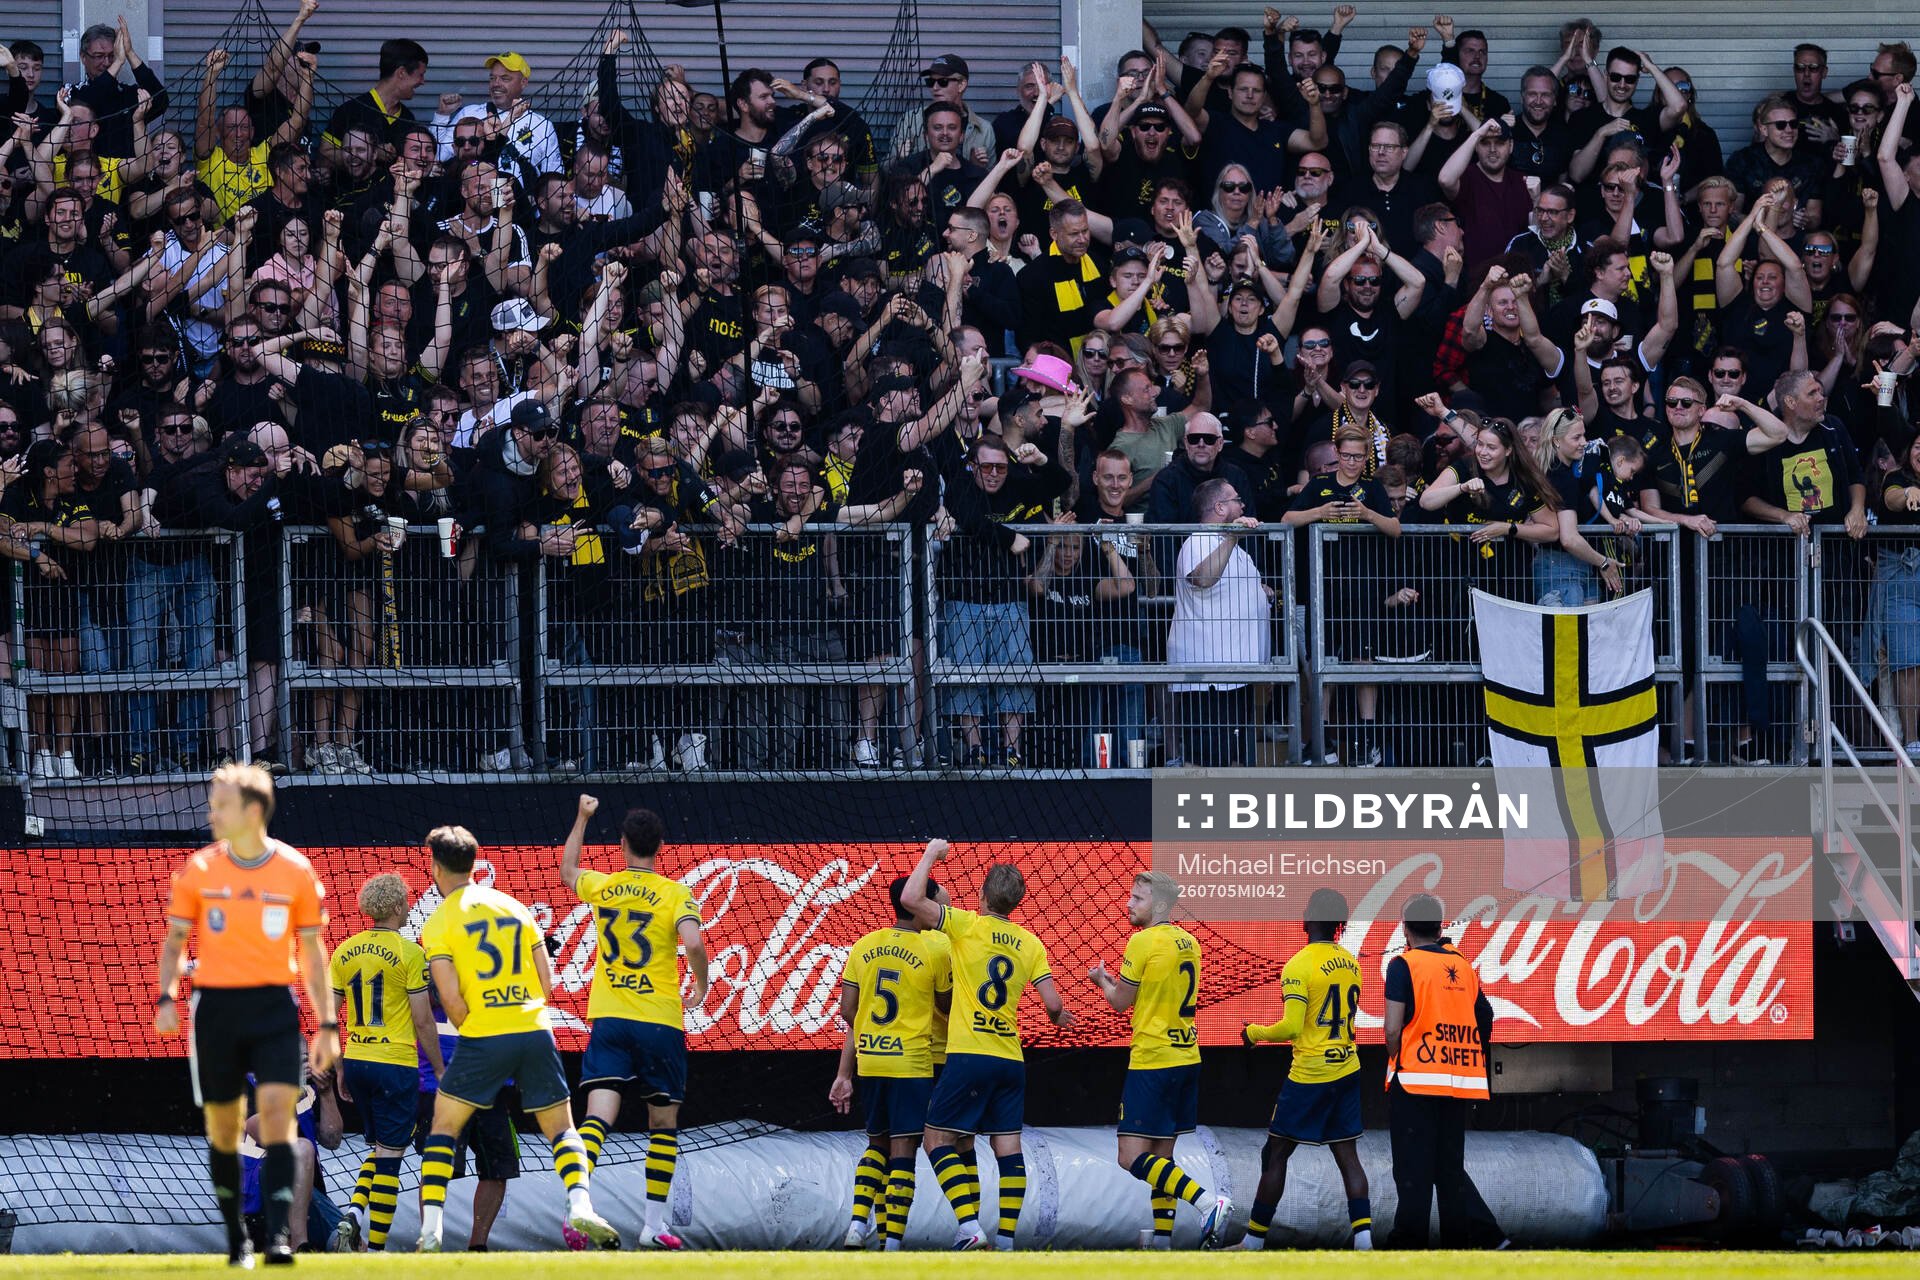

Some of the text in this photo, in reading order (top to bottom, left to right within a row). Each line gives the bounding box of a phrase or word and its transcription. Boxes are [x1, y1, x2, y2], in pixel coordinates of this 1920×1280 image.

[601, 884, 661, 907] CSONGVAI
[464, 916, 523, 980] 37
[598, 906, 654, 970] 33
[992, 932, 1022, 951] HOVE
[340, 943, 401, 968] ANDERSSON
[862, 945, 924, 970] BERGQUIST
[347, 968, 386, 1027] 11
[482, 985, 533, 1004] SVEA
[871, 967, 901, 1026] 5
[977, 954, 1014, 1011] 8
[1178, 961, 1197, 1018] 2
[1316, 984, 1360, 1041] 48
[858, 1033, 903, 1051] SVEA
[1417, 1032, 1436, 1063] &
[1435, 1023, 1480, 1045] SERVIC
